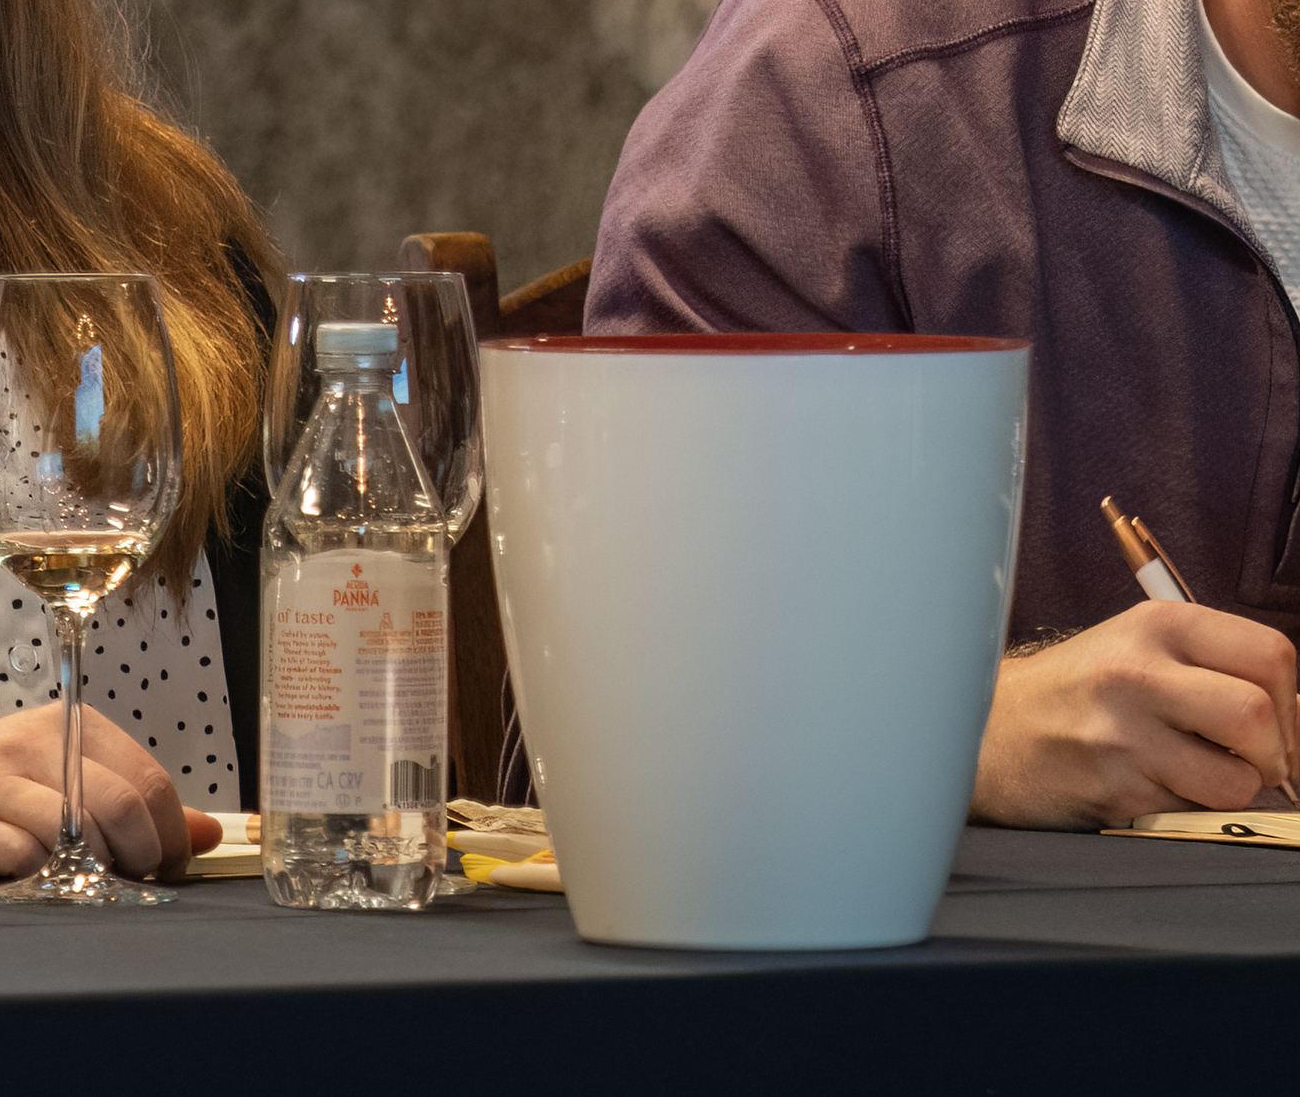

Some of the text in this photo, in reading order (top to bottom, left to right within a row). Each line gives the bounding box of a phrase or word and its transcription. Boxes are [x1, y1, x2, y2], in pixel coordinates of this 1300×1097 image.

[333, 589, 379, 606] PANNA
[277, 609, 335, 624] of taste
[317, 772, 334, 789] CA
[338, 772, 363, 790] CRV
